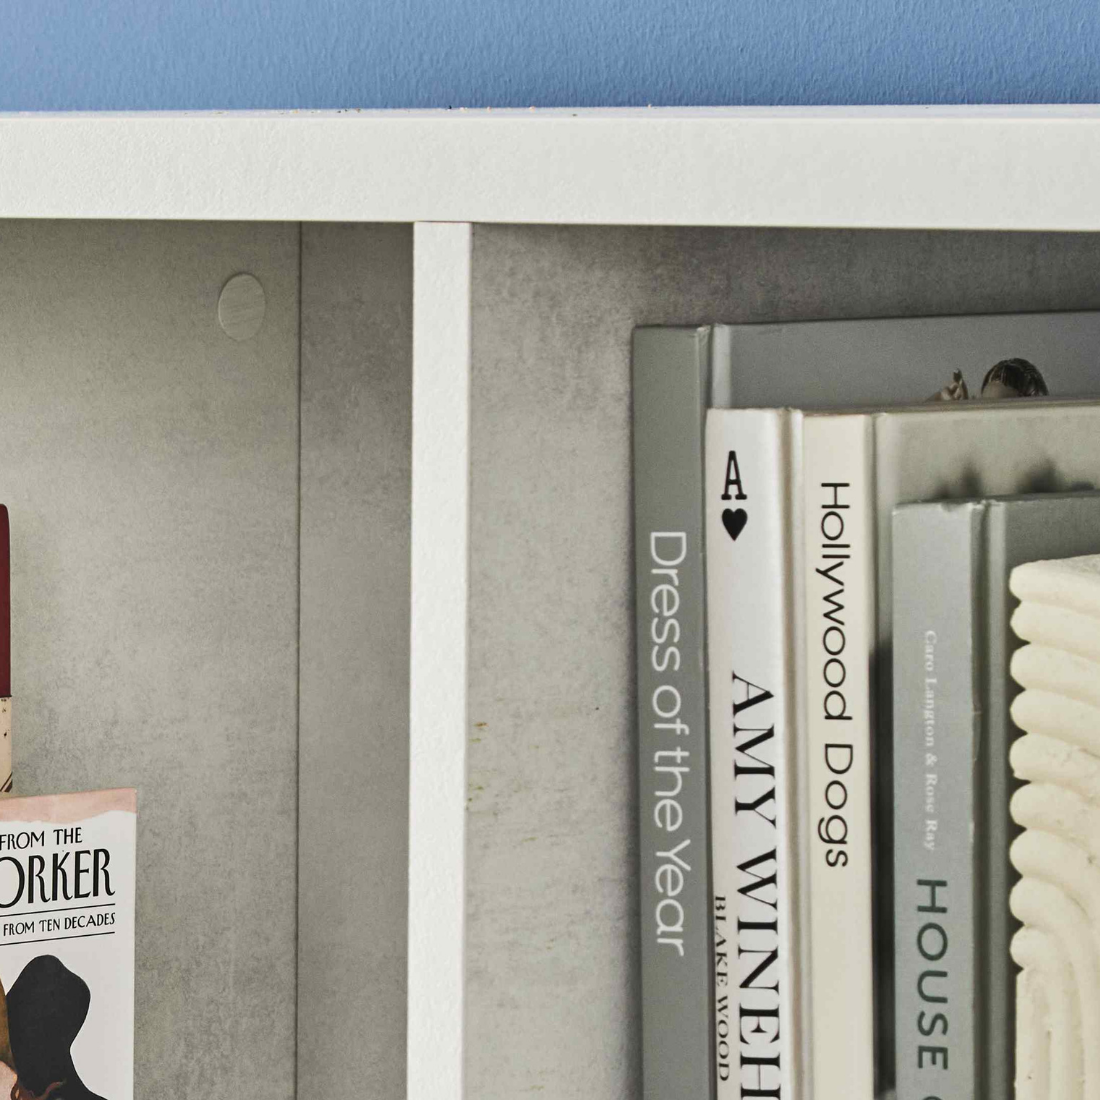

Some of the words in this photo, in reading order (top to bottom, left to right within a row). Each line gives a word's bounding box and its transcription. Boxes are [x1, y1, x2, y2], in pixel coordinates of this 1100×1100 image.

[721, 450, 747, 500] A
[650, 532, 686, 671] Dress
[815, 482, 853, 720] Hollywood
[924, 630, 937, 672] Caro
[653, 685, 690, 735] of
[924, 678, 937, 747] Langton
[732, 670, 776, 829] AMY
[926, 753, 937, 766] &
[654, 747, 690, 831] the
[818, 743, 853, 868] Dogs
[926, 773, 937, 813] Rose
[0, 831, 45, 851] FROM
[53, 827, 82, 845] THE
[924, 819, 937, 850] Ray
[3, 922, 35, 936] FROM
[39, 918, 61, 932] TEN
[64, 912, 115, 930] DECADES
[655, 839, 691, 957] Year
[715, 896, 728, 987] BLAKE
[917, 879, 948, 1070] HOUSE
[717, 996, 730, 1081] WOOD
